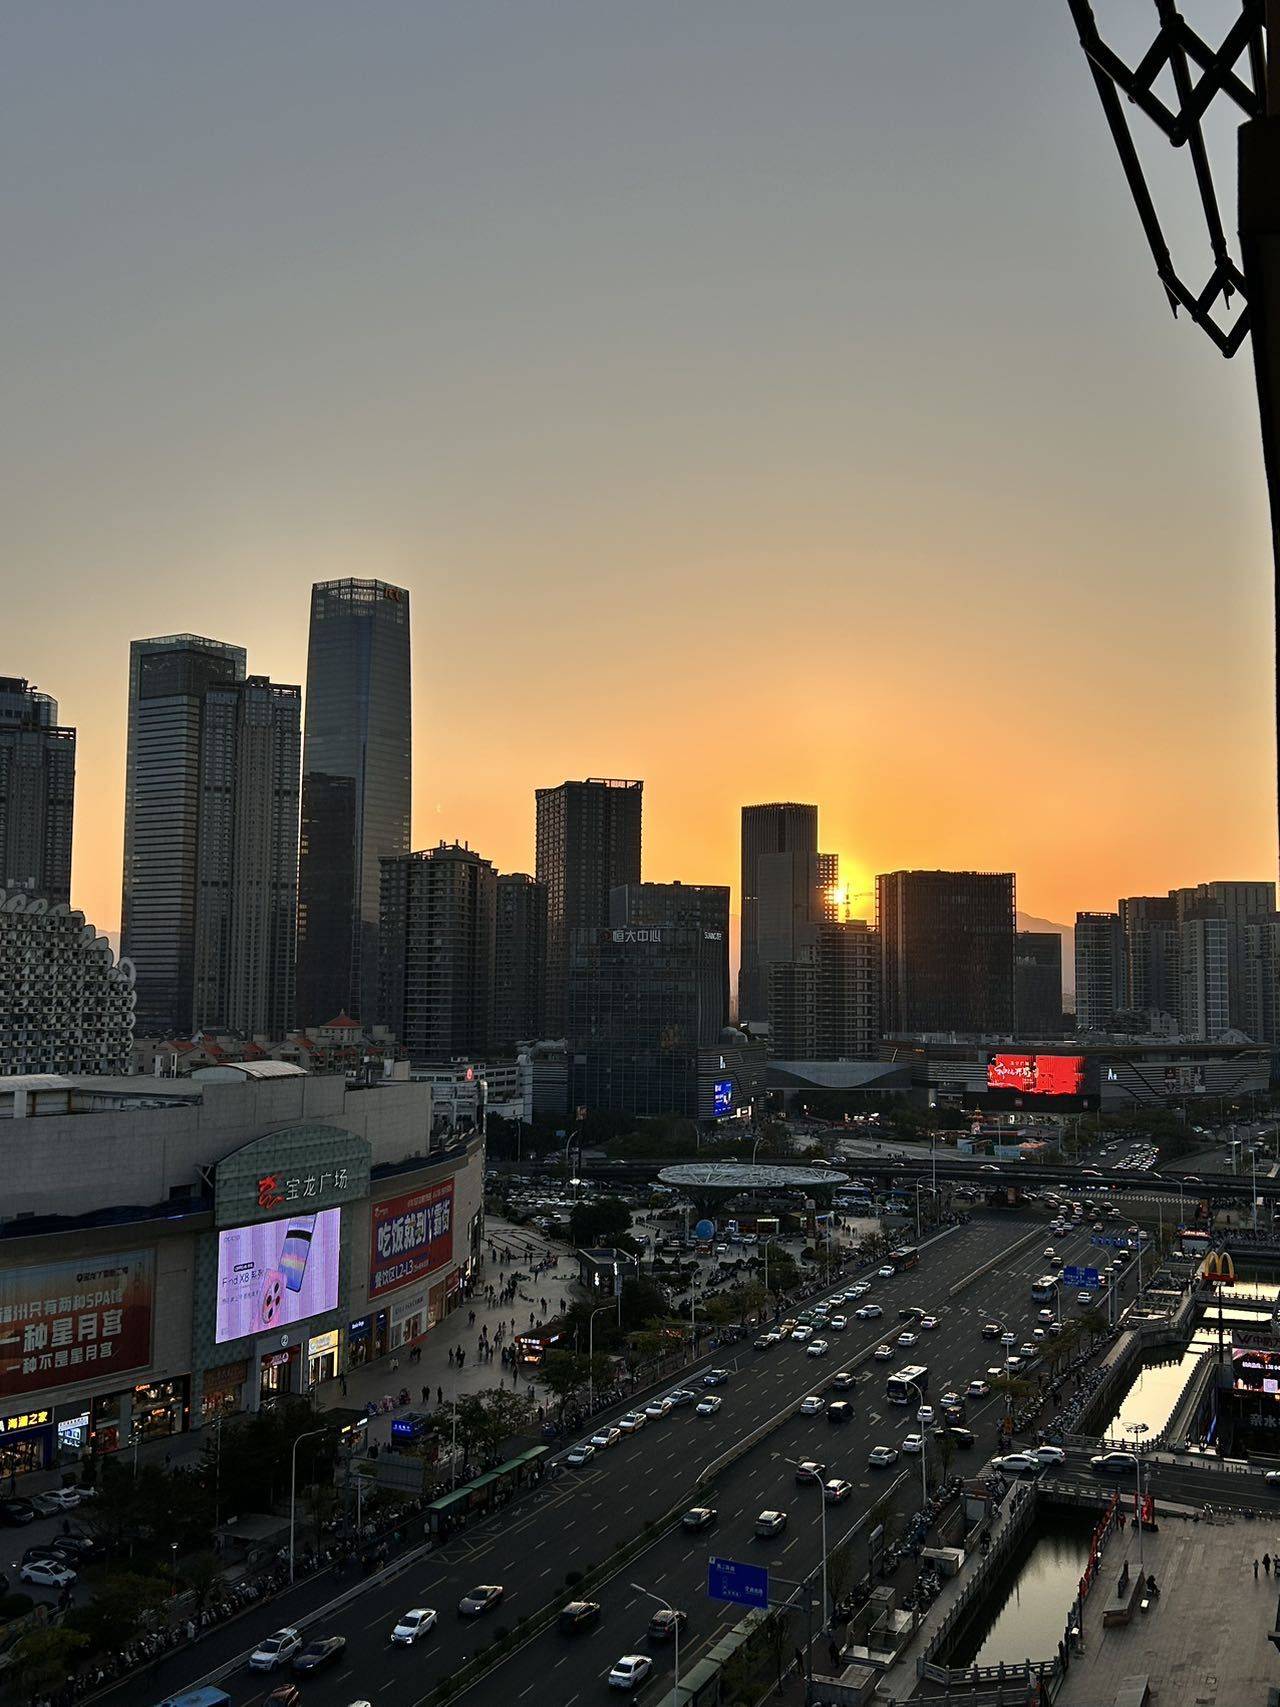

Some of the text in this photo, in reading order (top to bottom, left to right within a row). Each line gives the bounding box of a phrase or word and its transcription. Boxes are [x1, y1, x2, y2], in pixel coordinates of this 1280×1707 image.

[612, 929, 661, 943] 恒大中心
[286, 1168, 348, 1201] 宝龙广场
[6, 1341, 113, 1375] 一种不是星月宫
